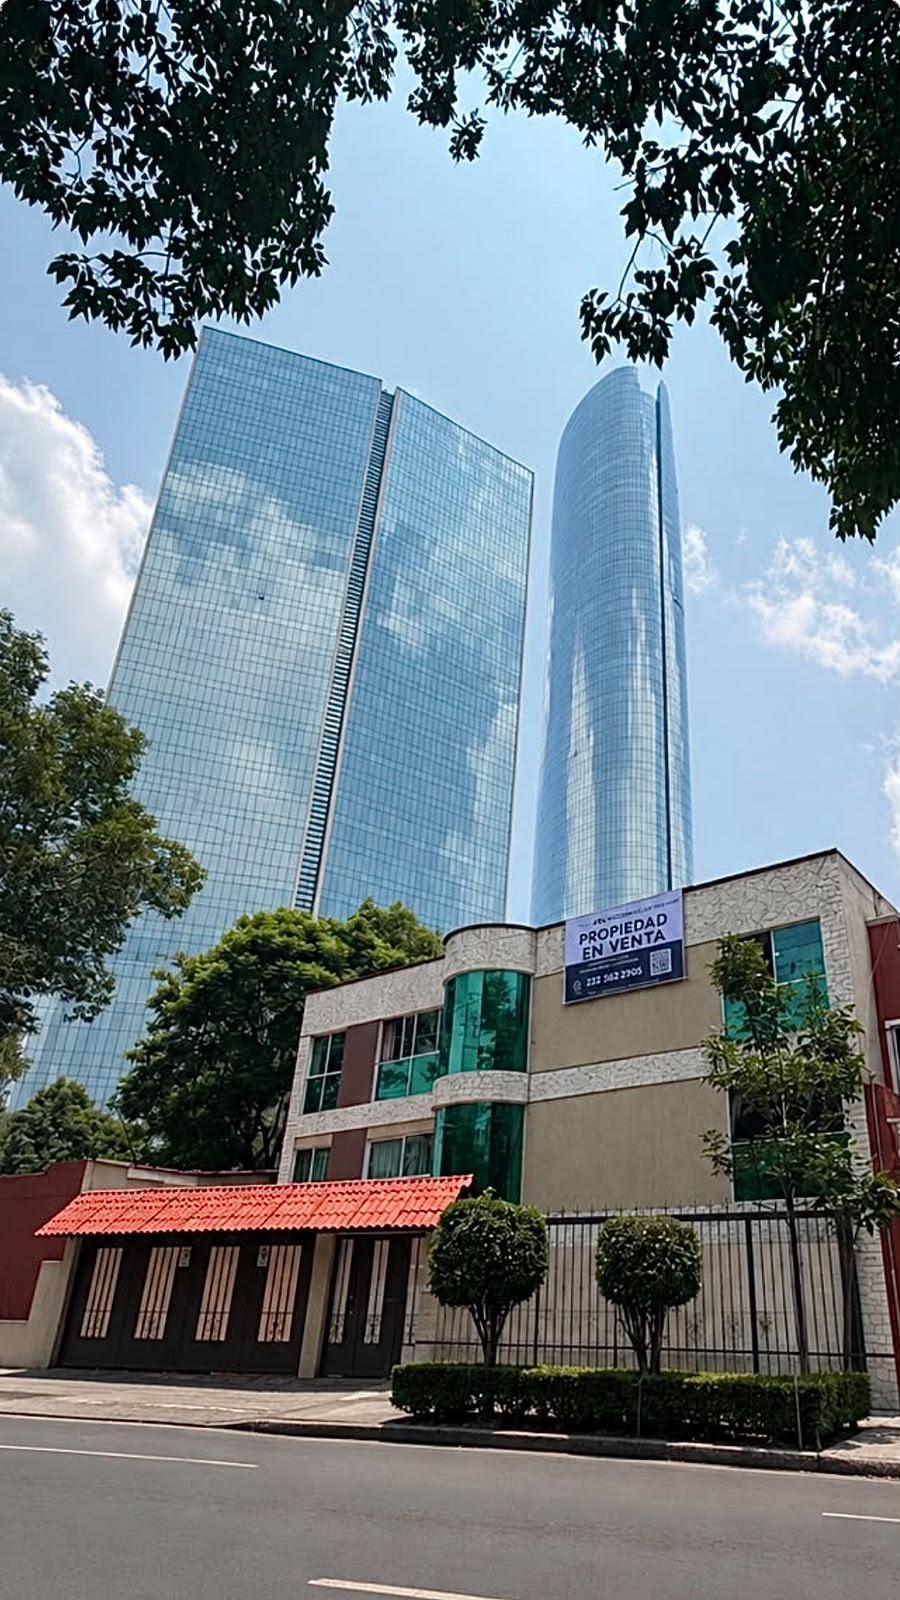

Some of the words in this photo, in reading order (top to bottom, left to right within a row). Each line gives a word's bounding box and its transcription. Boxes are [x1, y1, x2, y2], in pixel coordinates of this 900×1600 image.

[579, 913, 668, 945] PROPIEDAD
[583, 944, 603, 960] EN
[609, 929, 666, 953] VENTA
